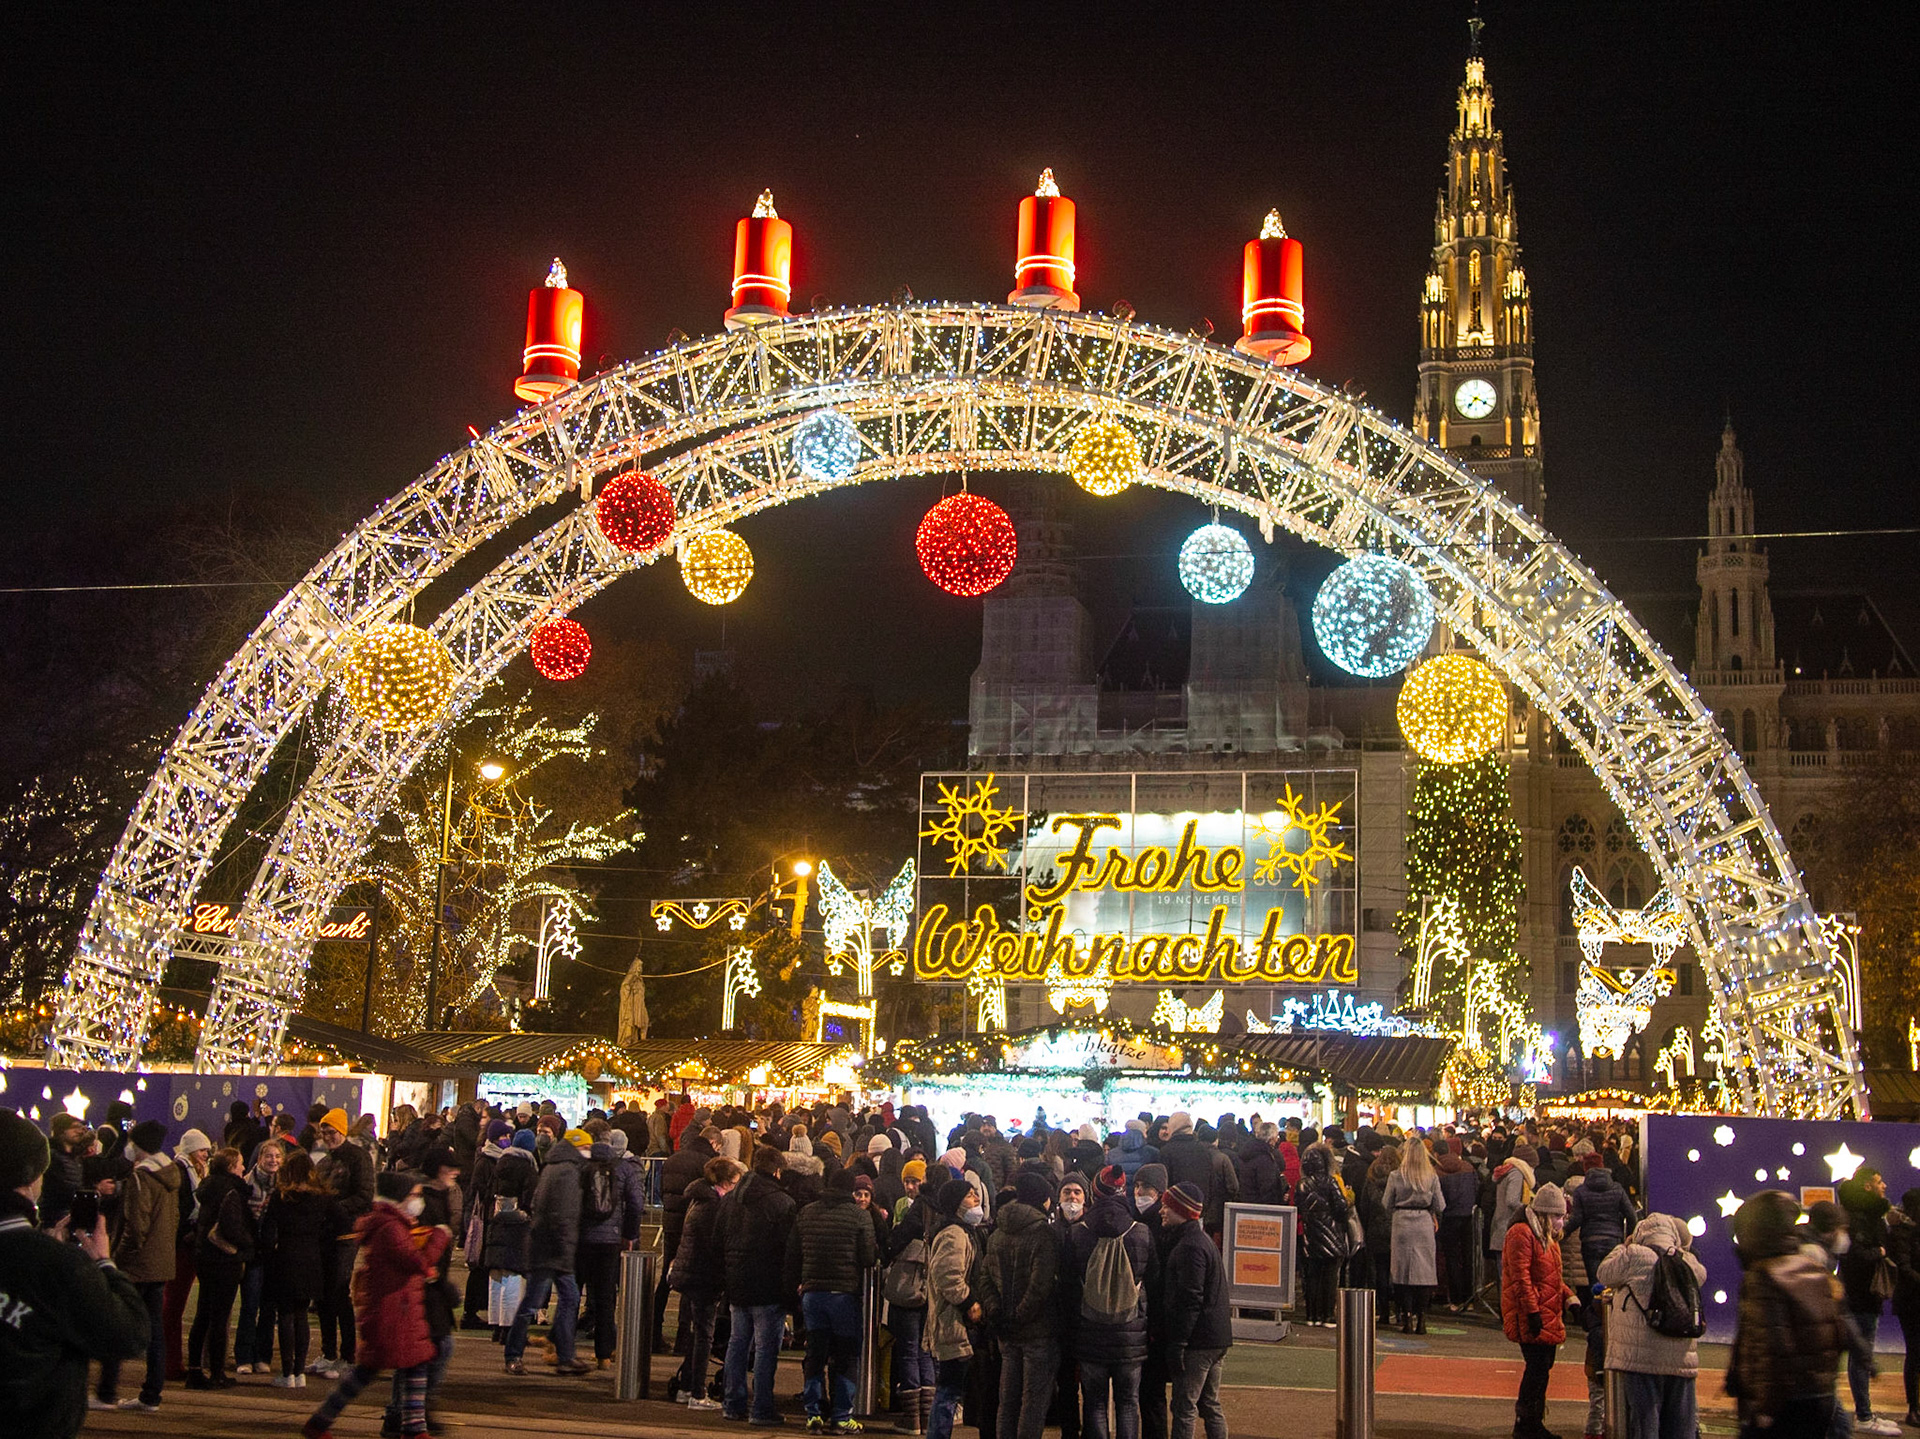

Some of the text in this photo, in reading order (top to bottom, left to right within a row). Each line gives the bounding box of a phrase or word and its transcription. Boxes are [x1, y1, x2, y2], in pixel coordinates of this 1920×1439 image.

[1024, 812, 1246, 906] Frohe
[1158, 895, 1244, 905] 19 NOVEMBE
[914, 903, 1359, 983] Weihnachten
